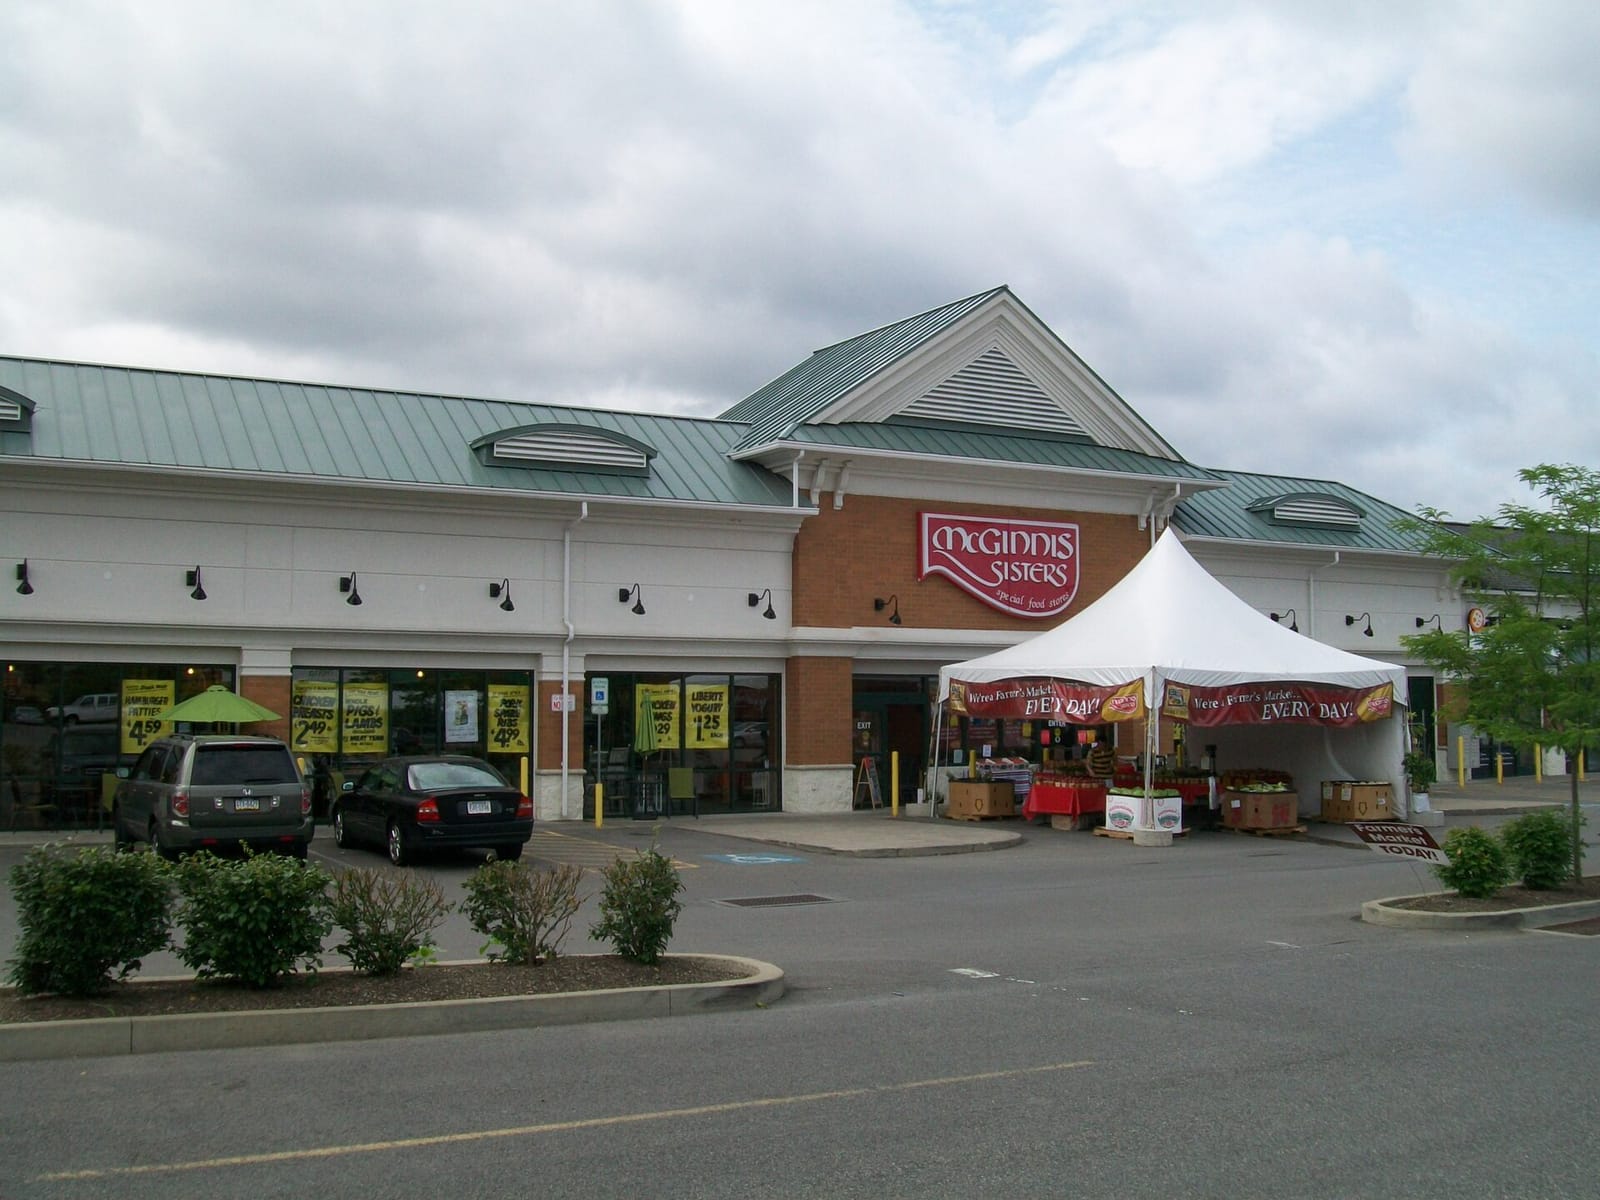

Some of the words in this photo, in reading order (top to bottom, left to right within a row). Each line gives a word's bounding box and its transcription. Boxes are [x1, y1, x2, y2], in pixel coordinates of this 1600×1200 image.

[990, 560, 1068, 588] SISTERS
[995, 589, 1025, 606] special
[1027, 597, 1046, 611] food
[1048, 592, 1070, 608] stores
[691, 691, 724, 702] LIBERTE
[128, 707, 161, 717] PATTIES
[691, 703, 724, 713] YOGURT
[1066, 698, 1100, 715] DAY!
[1261, 701, 1315, 720] EVERY
[1319, 700, 1354, 718] DAY!
[344, 717, 384, 729] LAMBS
[857, 721, 871, 729] EXIT
[1047, 719, 1067, 728] ENTER
[1354, 823, 1424, 836] Farmers
[1368, 832, 1429, 846] Market
[1378, 844, 1440, 862] TODAY!
